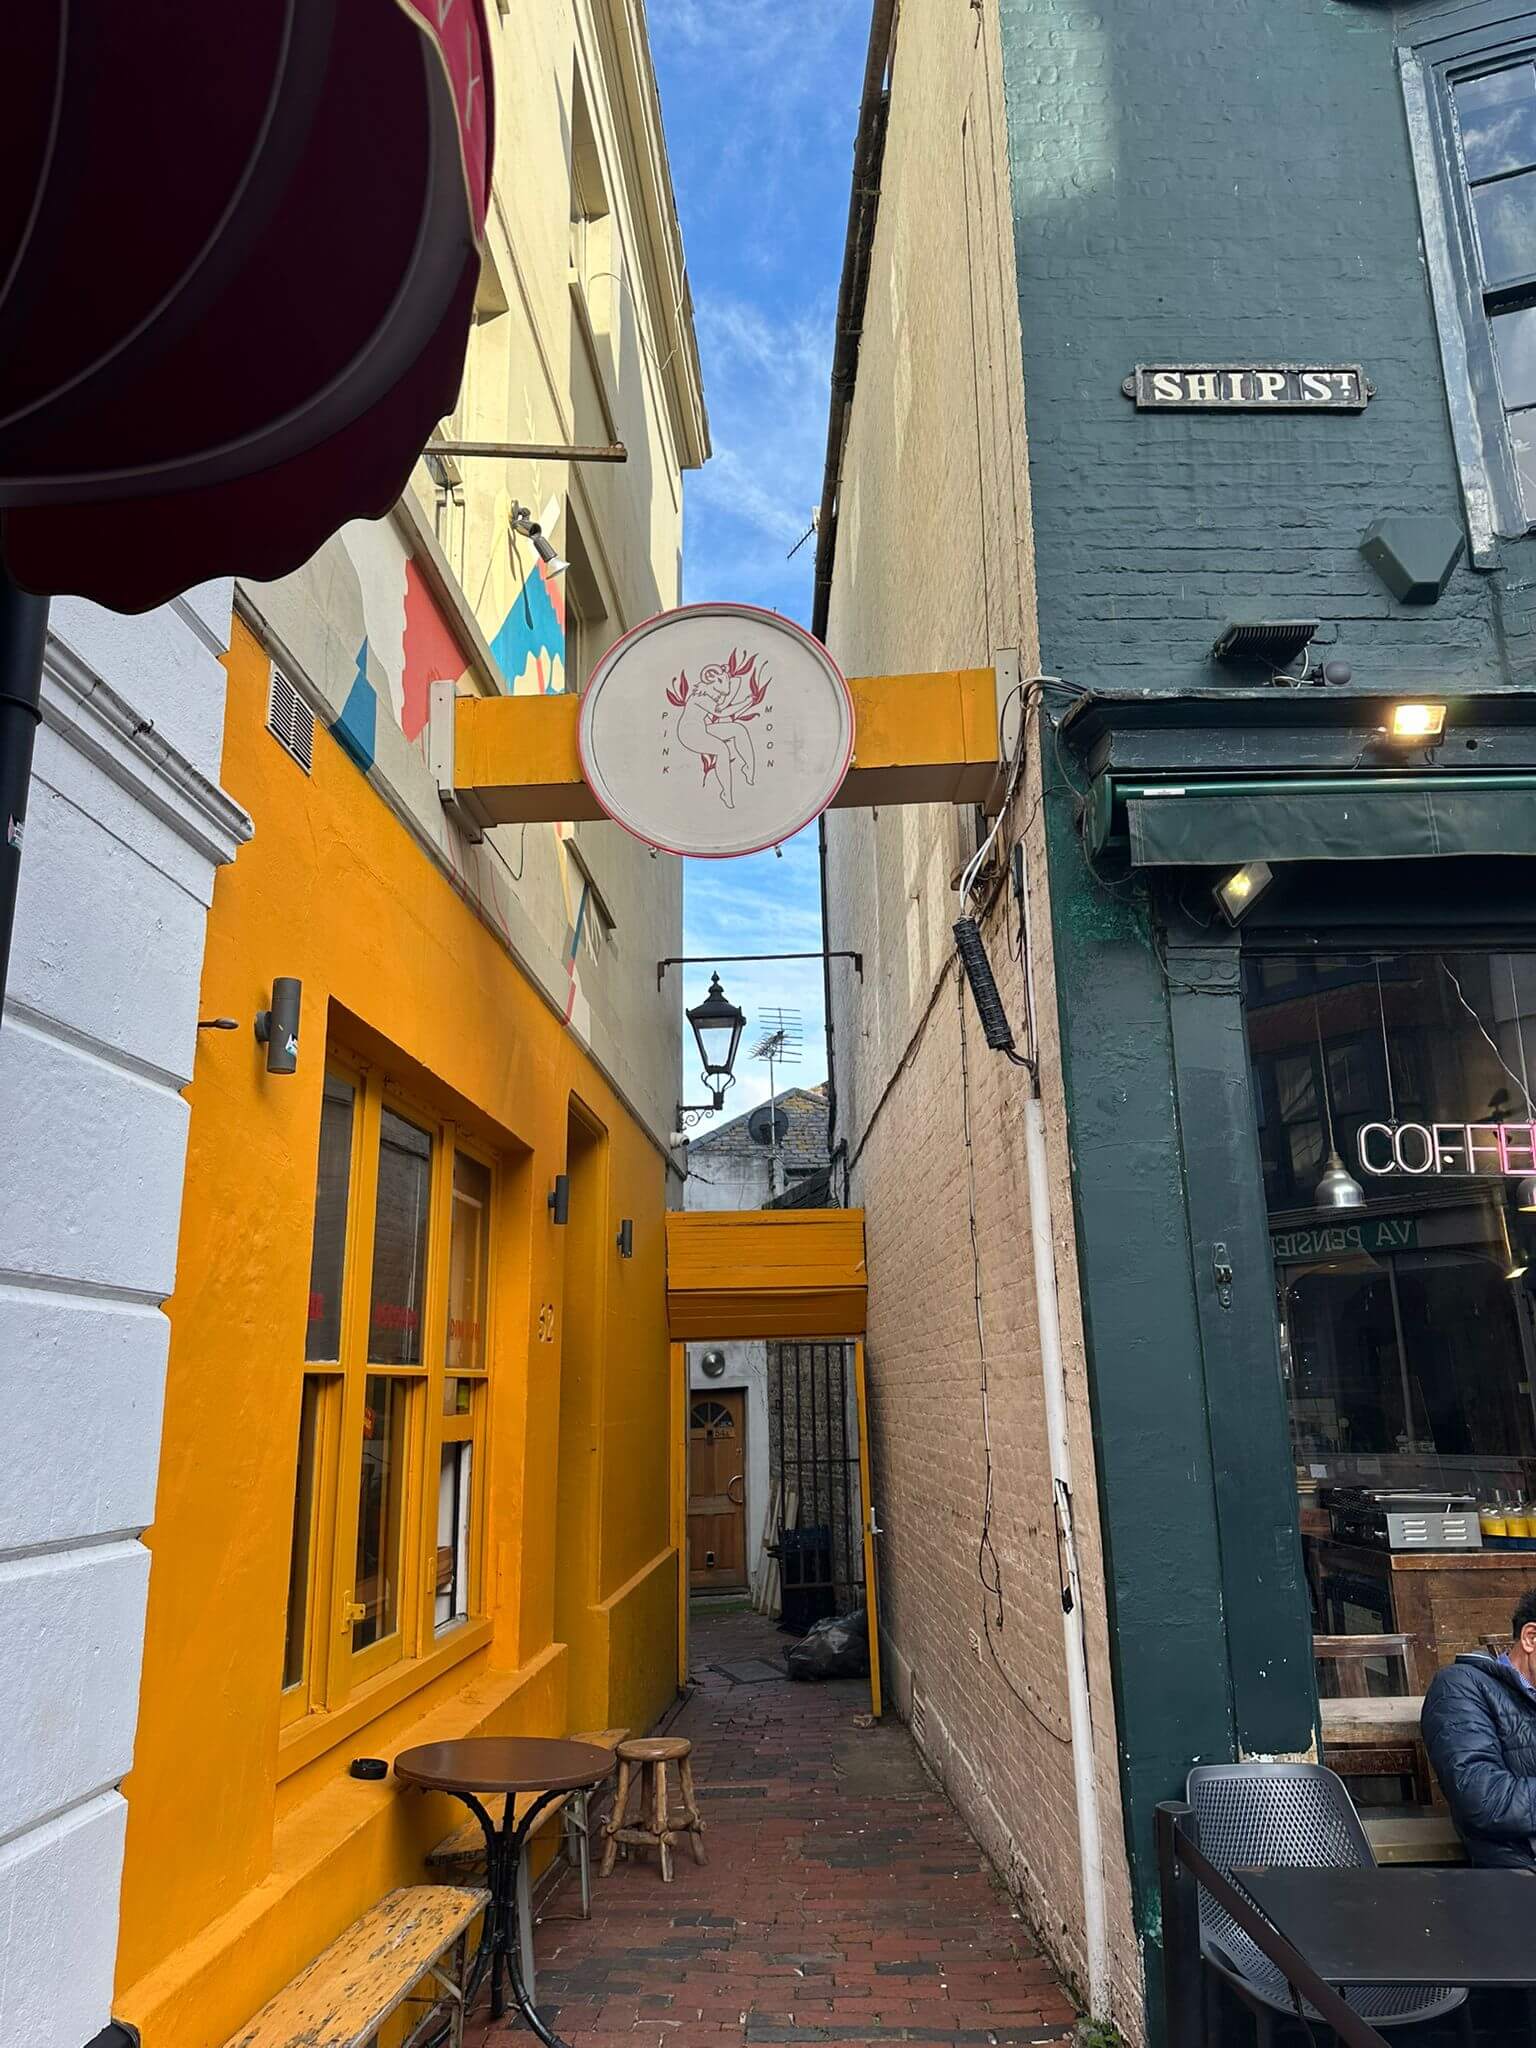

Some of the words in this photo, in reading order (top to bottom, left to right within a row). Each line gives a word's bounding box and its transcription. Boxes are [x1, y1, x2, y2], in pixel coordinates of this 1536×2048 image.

[1153, 372, 1287, 400] SHIP
[661, 711, 671, 774] PINK
[764, 705, 775, 768] MOON
[1358, 1122, 1536, 1174] COFFE
